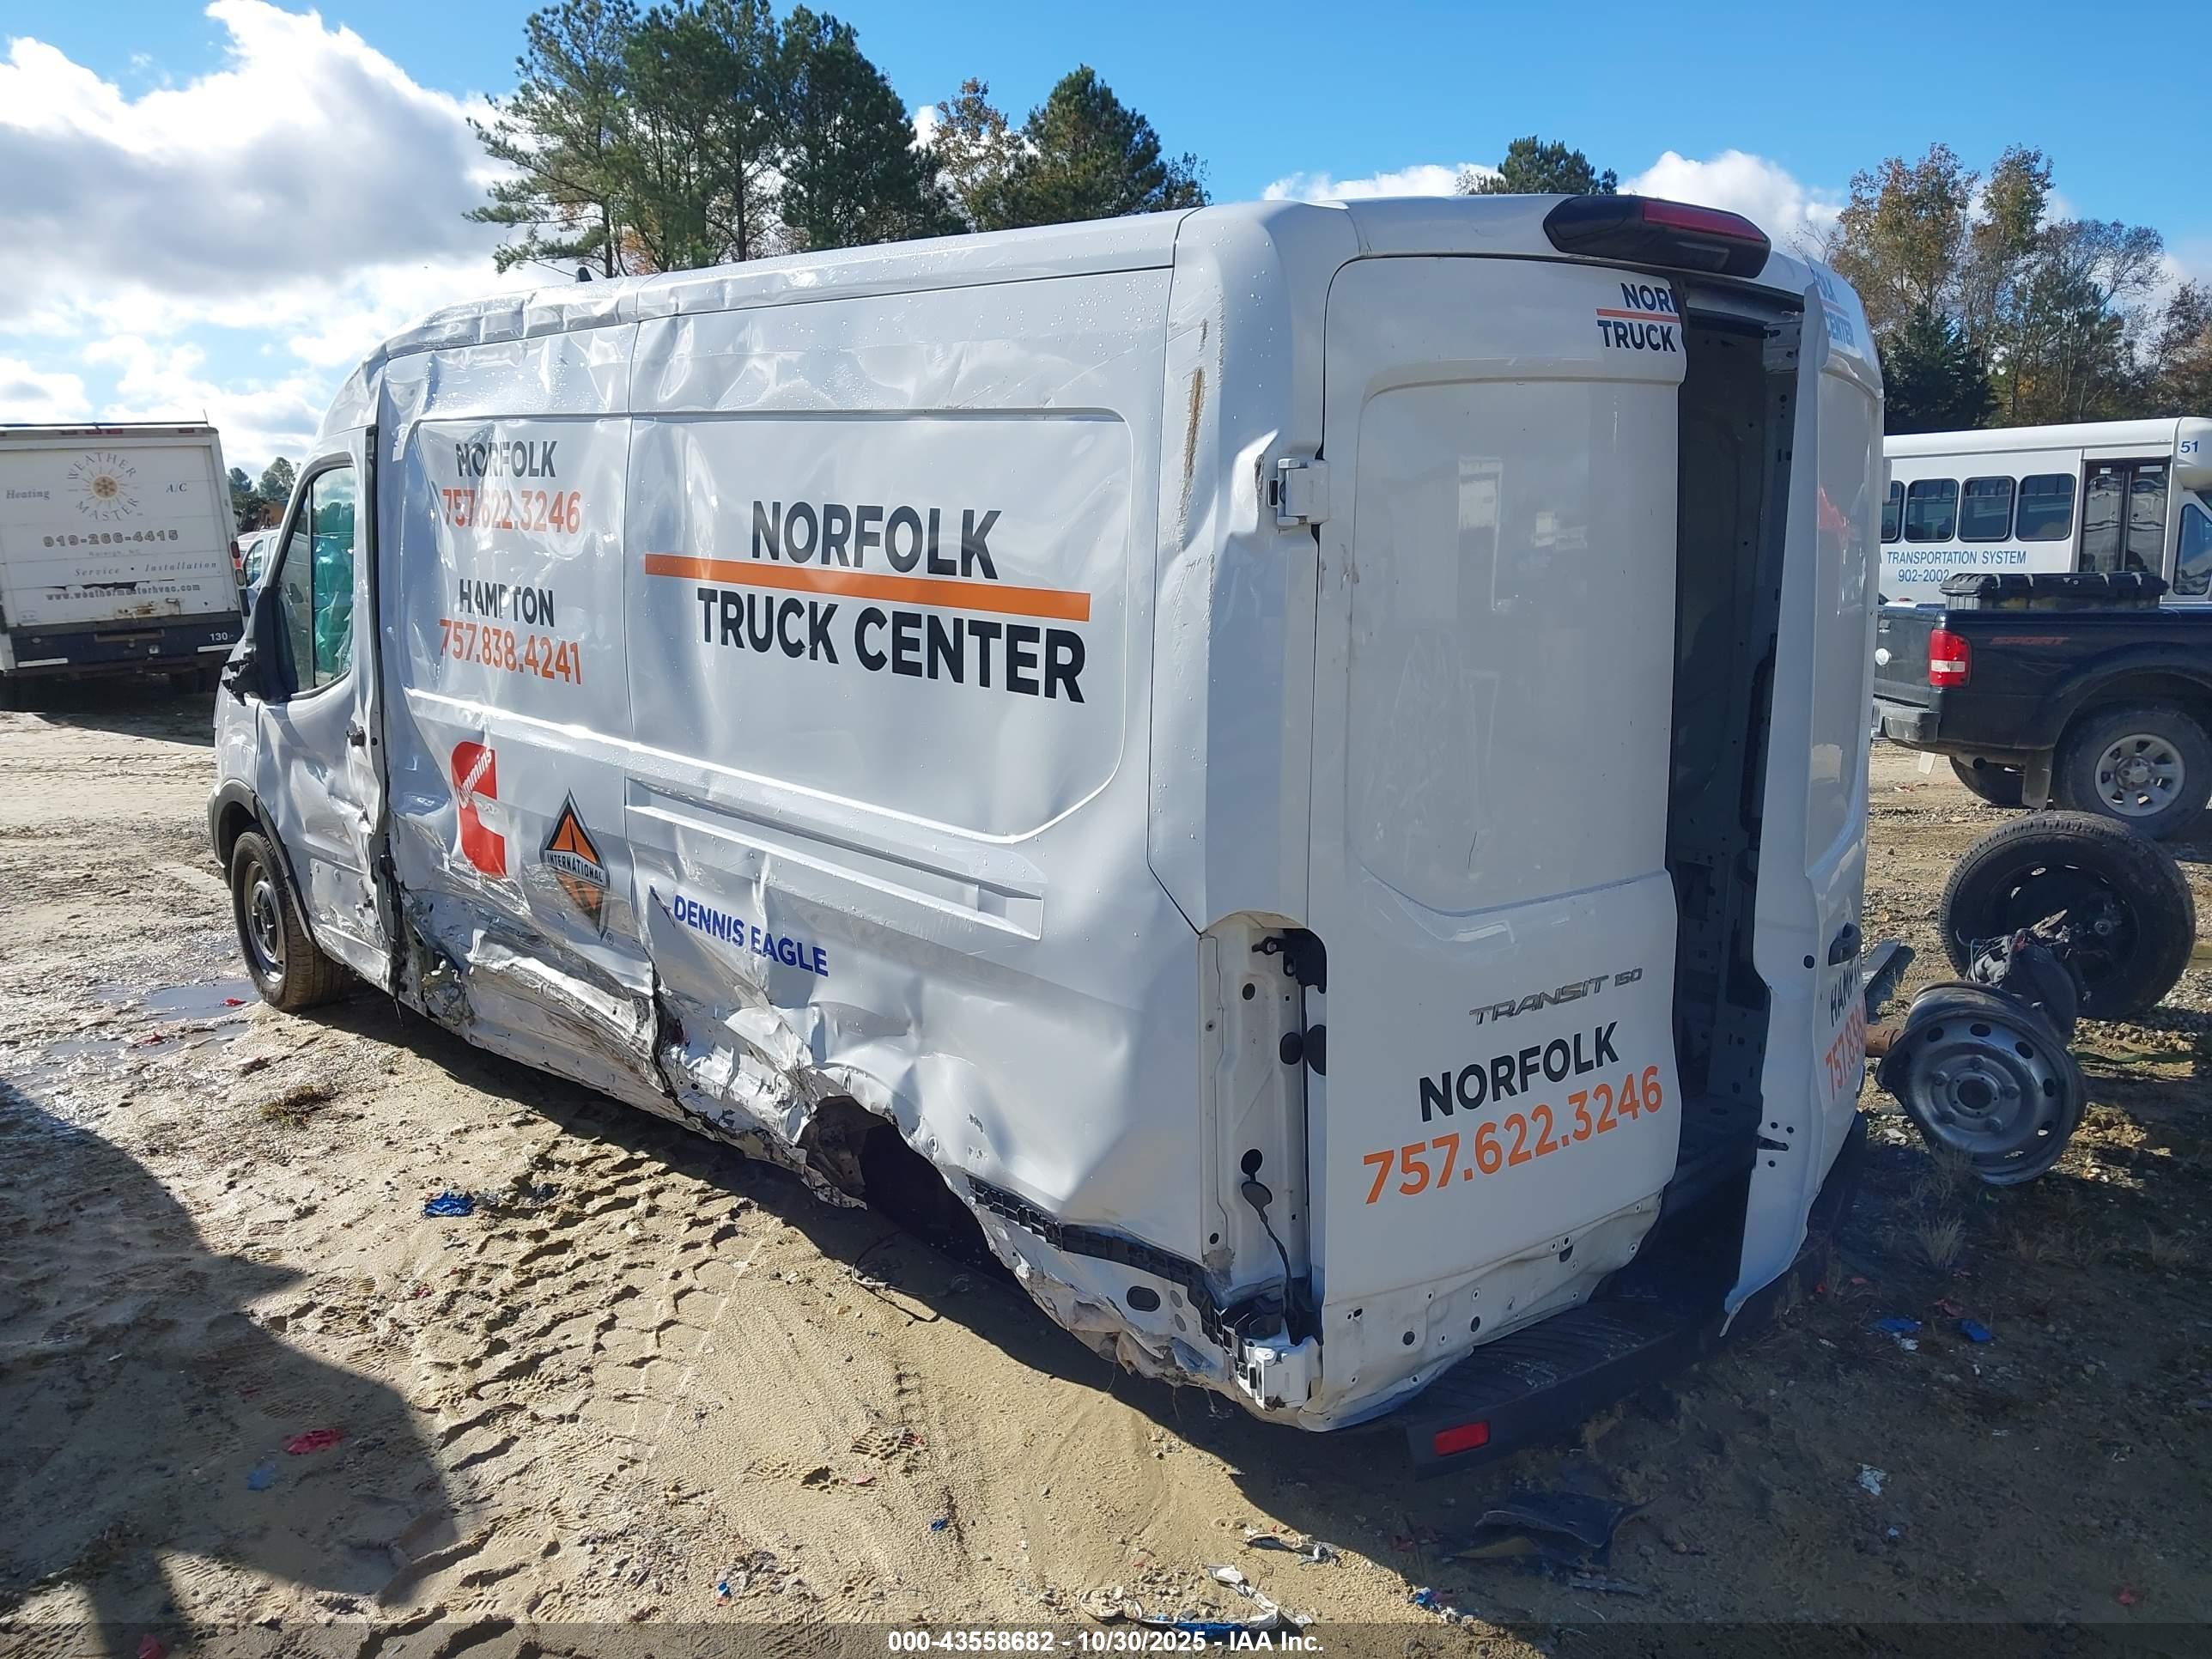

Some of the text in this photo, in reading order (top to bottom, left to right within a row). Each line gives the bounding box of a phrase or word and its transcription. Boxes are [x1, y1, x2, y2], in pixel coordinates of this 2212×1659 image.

[1597, 319, 1676, 352] TRUCK
[455, 440, 557, 478] NORFOLK
[2180, 441, 2199, 453] 51
[68, 452, 137, 480] WEATHER
[6, 489, 50, 501] Heating
[166, 483, 188, 493] A/C
[76, 497, 140, 522] MASTER
[441, 489, 581, 534] 757.622.3246
[751, 500, 1002, 580] NORFOLK
[1887, 550, 2027, 564] TRANSPORTATION SYSTEM
[75, 561, 216, 576] Service Installation
[1898, 568, 1949, 582] 902-2002
[459, 578, 555, 628] HAMPTON
[210, 632, 228, 642] 130
[439, 618, 581, 685] 757.838.4241
[696, 587, 1085, 704] TRUCK CENTER
[456, 747, 492, 809] Cummins
[547, 853, 604, 883] INTERNATIONAL
[672, 894, 830, 977] DENNIS EAGLE
[1469, 968, 1644, 1025] TRANSIT 150
[1419, 1021, 1620, 1122] NORFOLK
[1363, 1065, 1663, 1205] 757.622.3246
